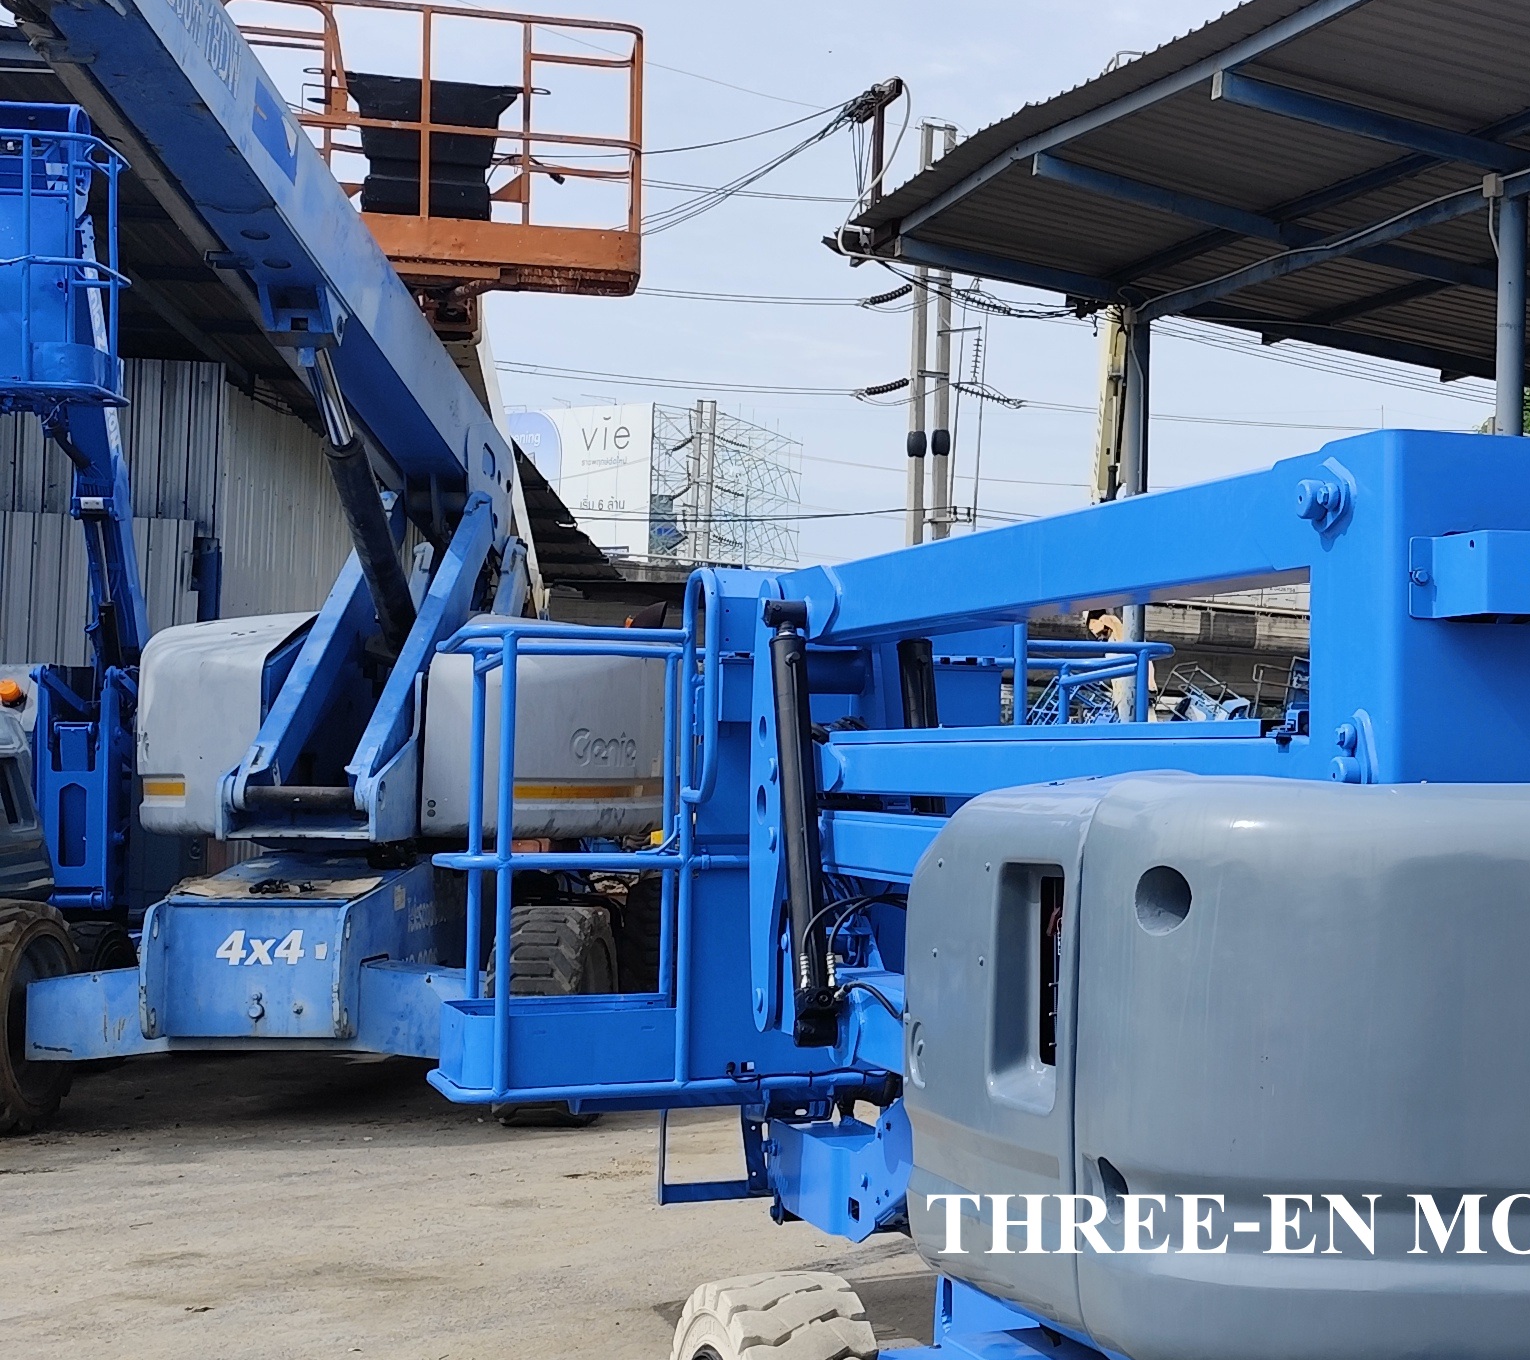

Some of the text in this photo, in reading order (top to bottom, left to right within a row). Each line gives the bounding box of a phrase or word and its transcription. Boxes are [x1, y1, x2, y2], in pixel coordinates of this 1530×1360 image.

[512, 430, 541, 447] ening
[569, 727, 638, 767] Genie
[215, 928, 306, 968] 4x4
